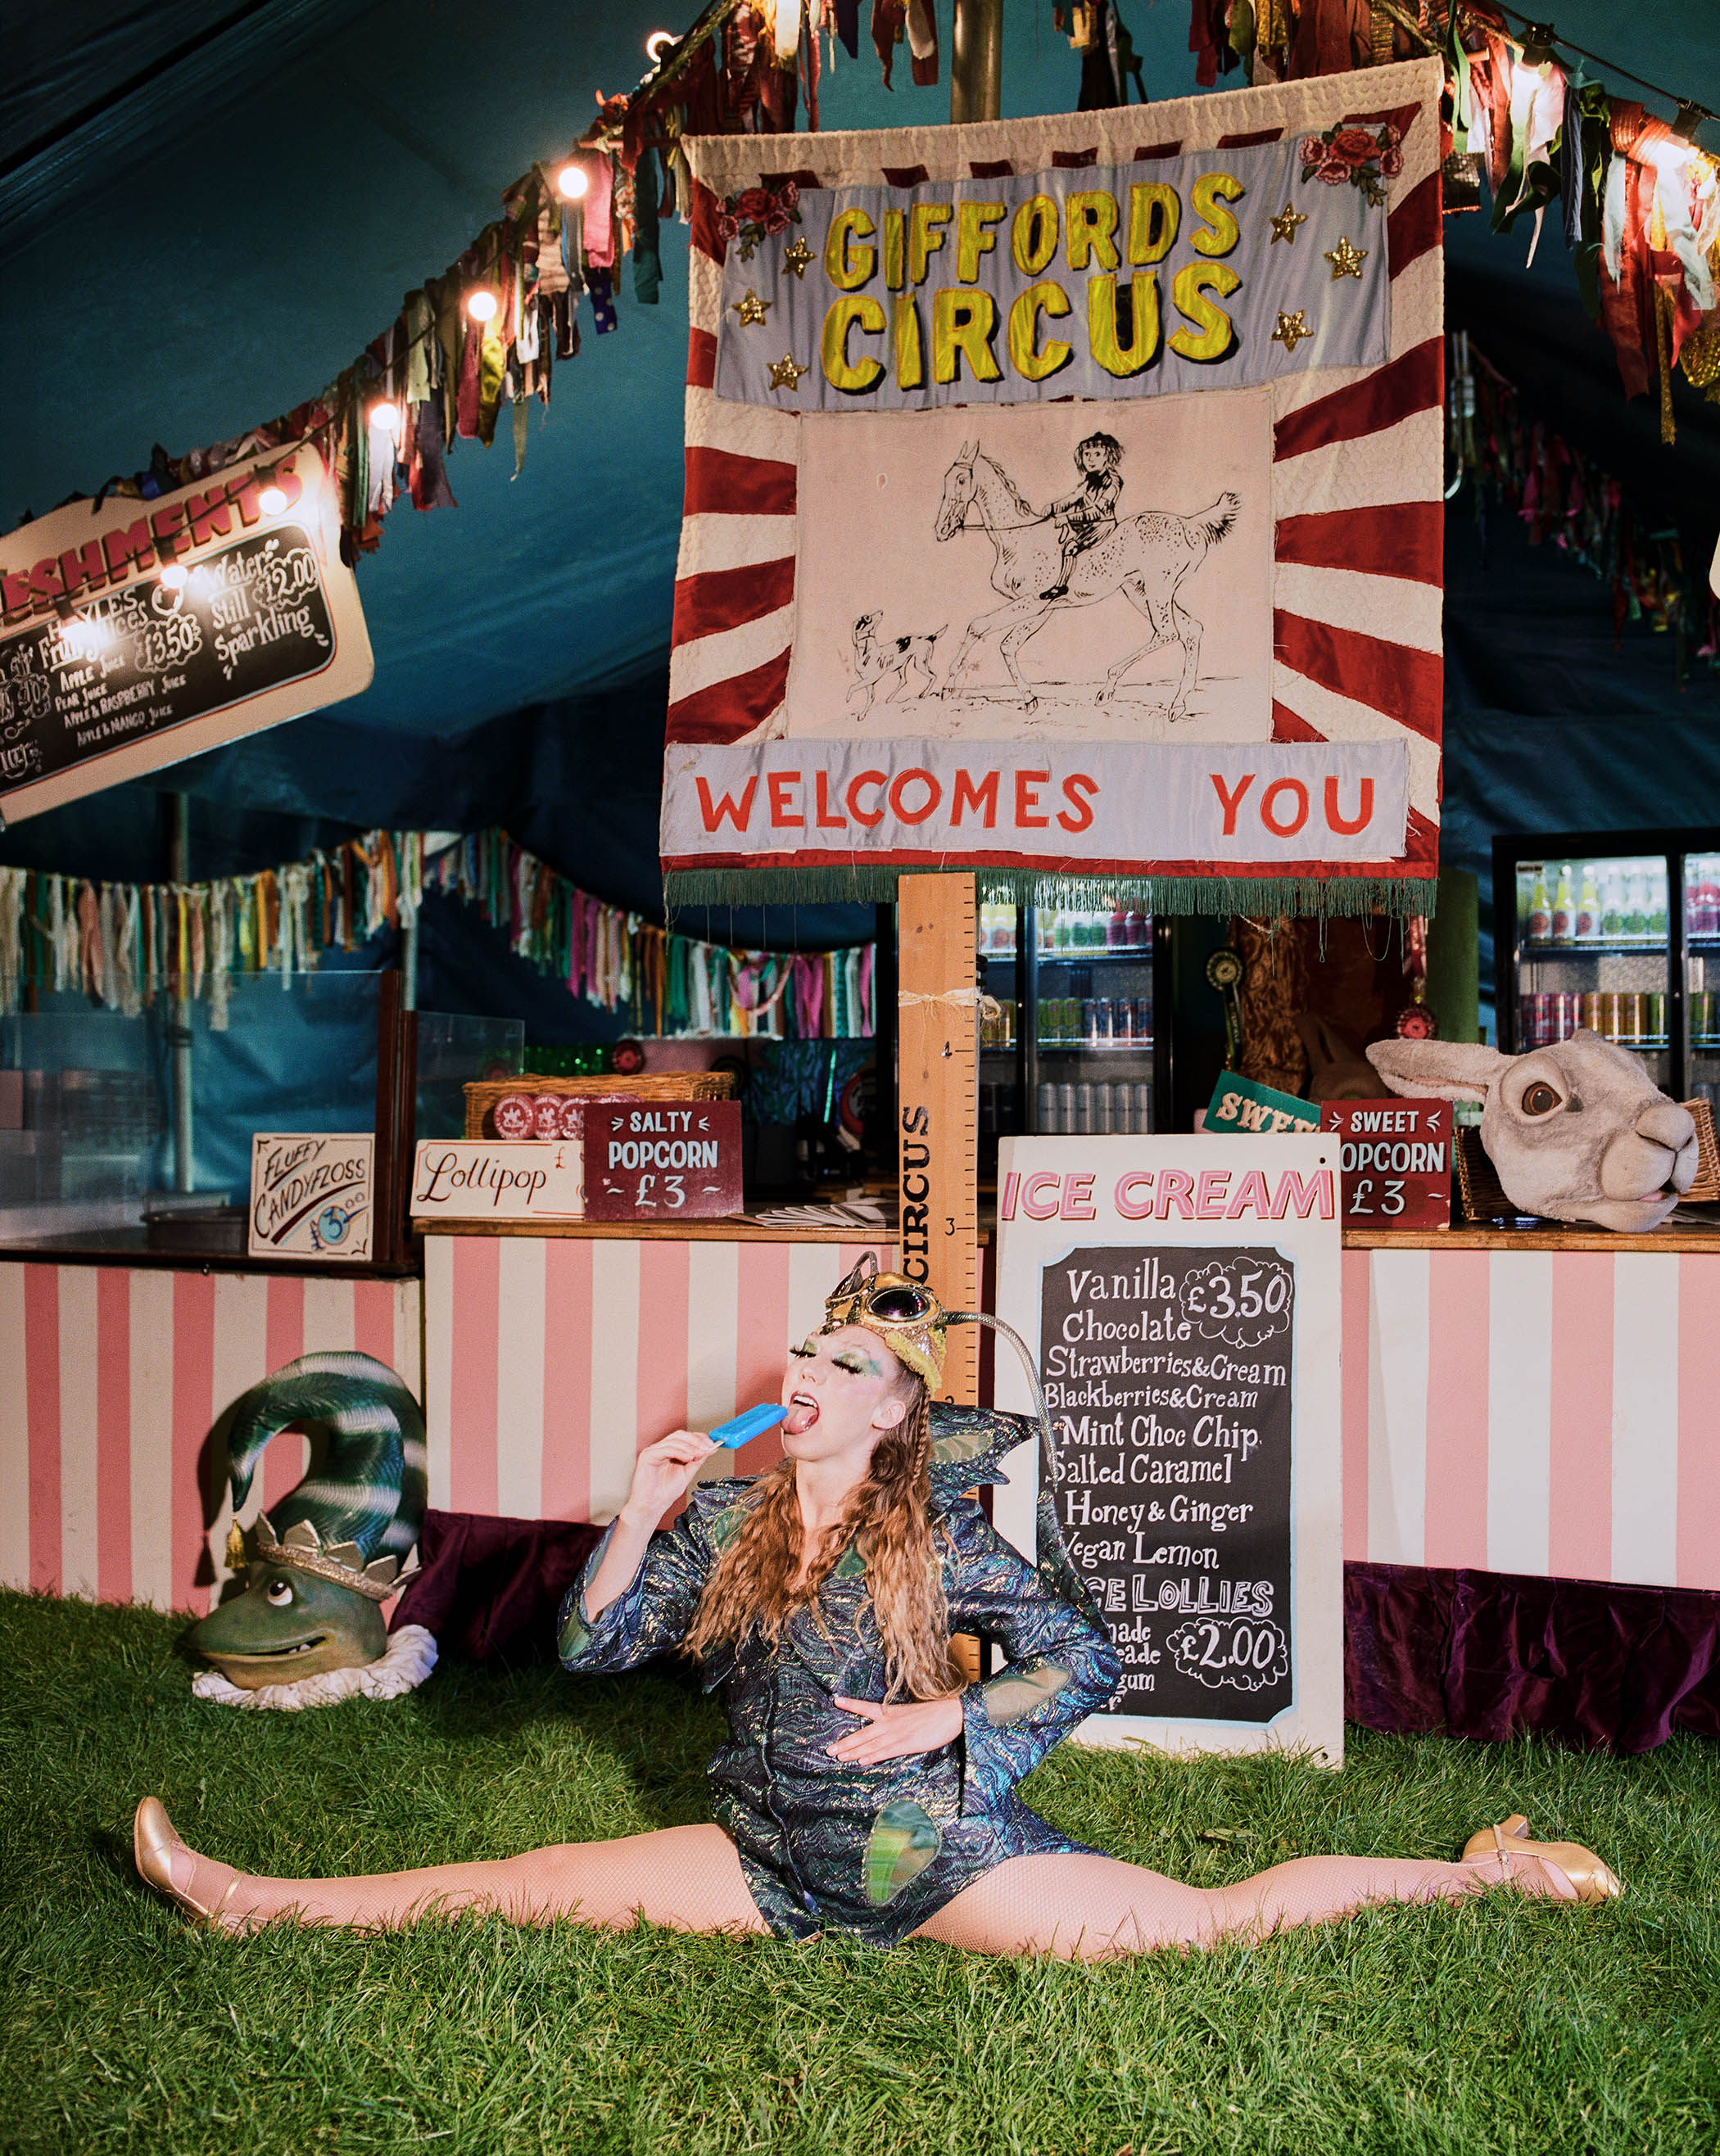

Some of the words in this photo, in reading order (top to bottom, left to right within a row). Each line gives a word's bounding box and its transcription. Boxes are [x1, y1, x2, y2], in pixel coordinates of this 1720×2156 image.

[823, 173, 1244, 291] GIFFORDS
[820, 260, 1242, 392] CIRCUS
[48, 586, 138, 641] HYLES
[211, 585, 251, 630] Still
[215, 605, 315, 667] Sparkling
[55, 693, 80, 712] PEAR
[695, 766, 1101, 834] WELCOMES
[1210, 773, 1375, 838] YOU
[629, 1110, 694, 1132] SALTY
[1215, 1092, 1321, 1133] SWE
[1350, 1110, 1420, 1132] SWEET
[264, 1139, 327, 1186] FLUFFY
[608, 1141, 719, 1171] POPCORN
[1341, 1141, 1445, 1173] OPCORN
[255, 1158, 366, 1239] CANDYFLOSS
[416, 1152, 547, 1207] Lollipop
[634, 1173, 687, 1209] £3
[903, 1105, 930, 1289] CIRCUS
[1001, 1170, 1097, 1221] ICE
[1114, 1168, 1336, 1221] CREAM
[1349, 1179, 1406, 1215] £3
[944, 1218, 955, 1236] 3
[1066, 1257, 1176, 1304] Vanilla
[1187, 1269, 1288, 1319] £3.50
[1062, 1308, 1192, 1342] Chocolate
[1060, 1412, 1125, 1447] Mint
[1130, 1414, 1186, 1448] Choc
[1130, 1453, 1233, 1485] Caramel
[1065, 1489, 1147, 1534] Honey
[1147, 1500, 1166, 1523] &
[1170, 1495, 1253, 1532] Ginger
[1133, 1530, 1220, 1570] Lemon
[1131, 1574, 1274, 1617] LOLLIES
[1115, 1643, 1161, 1665] eade
[1180, 1625, 1276, 1670] £2.00
[1116, 1673, 1156, 1696] gum
